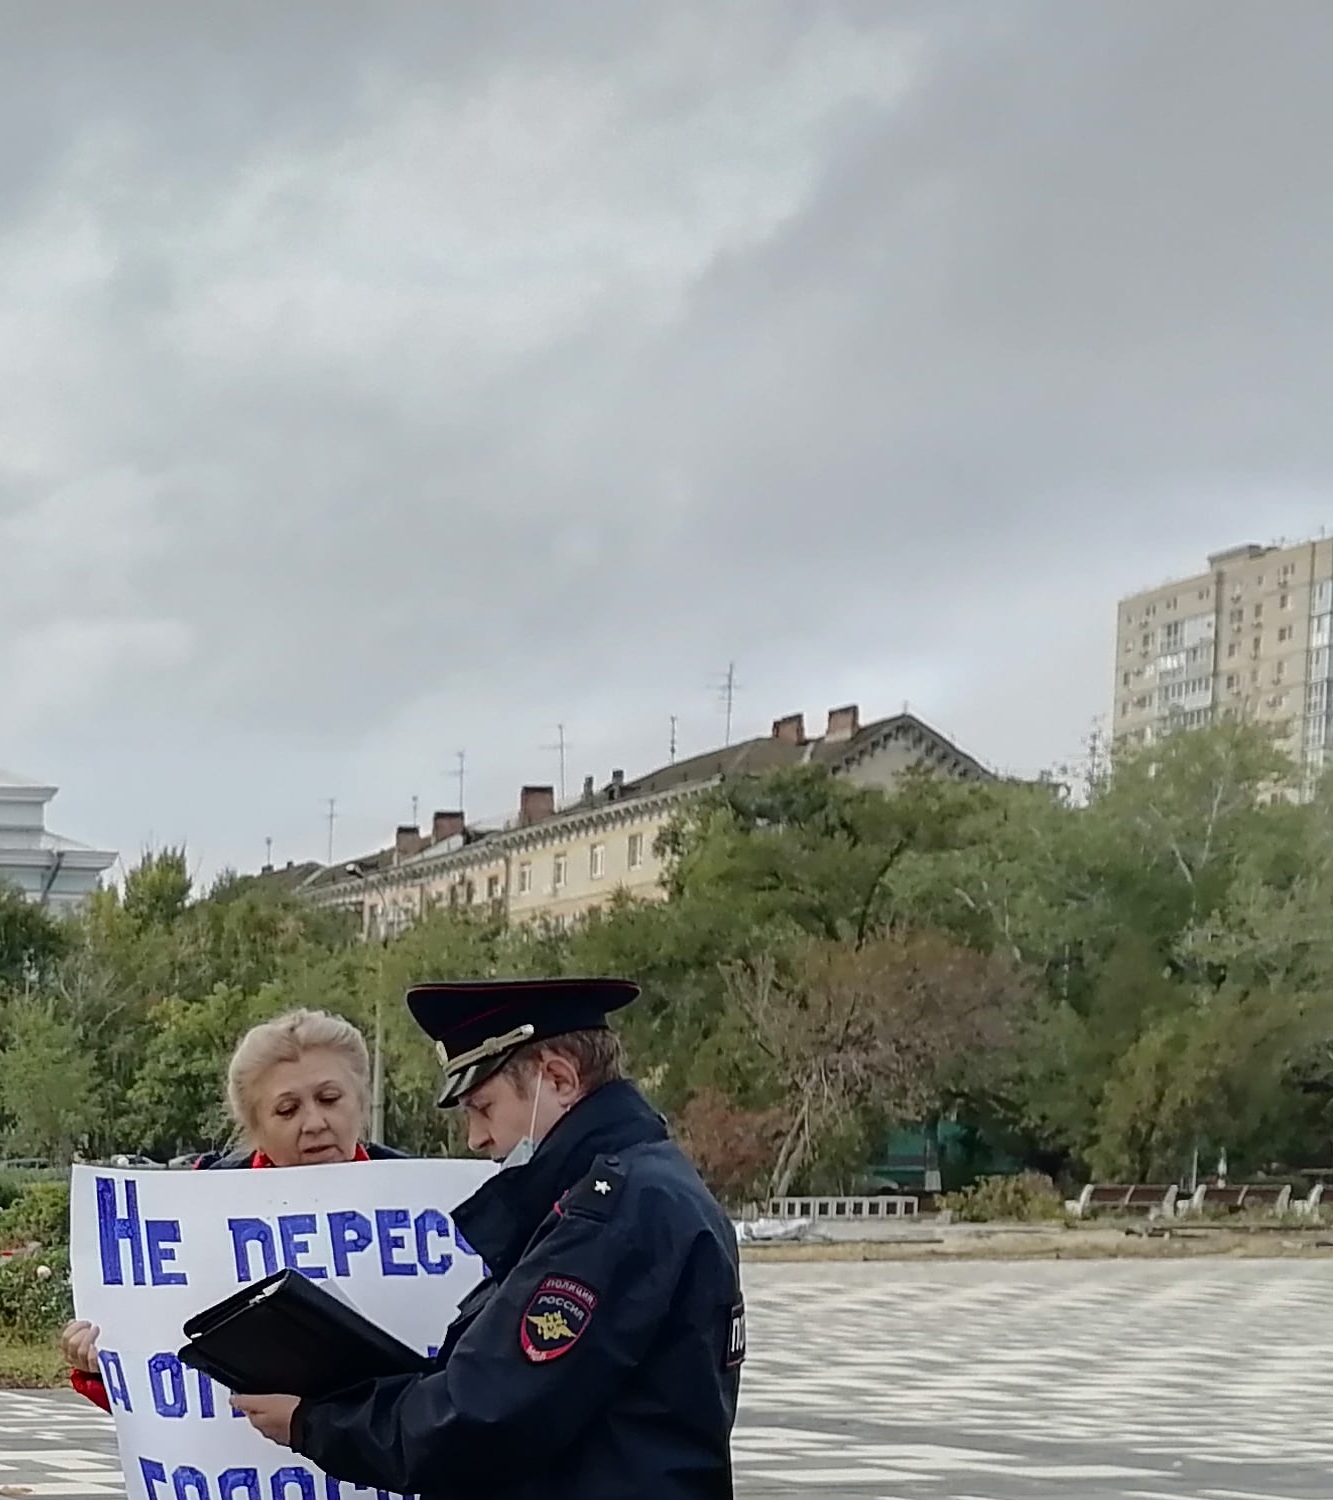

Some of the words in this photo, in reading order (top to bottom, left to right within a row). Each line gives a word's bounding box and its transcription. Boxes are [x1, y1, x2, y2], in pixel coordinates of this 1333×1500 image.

[96, 1177, 188, 1286] НЕ
[228, 1208, 493, 1283] ПЕРЕС
[537, 1295, 585, 1320] РОССИЯ
